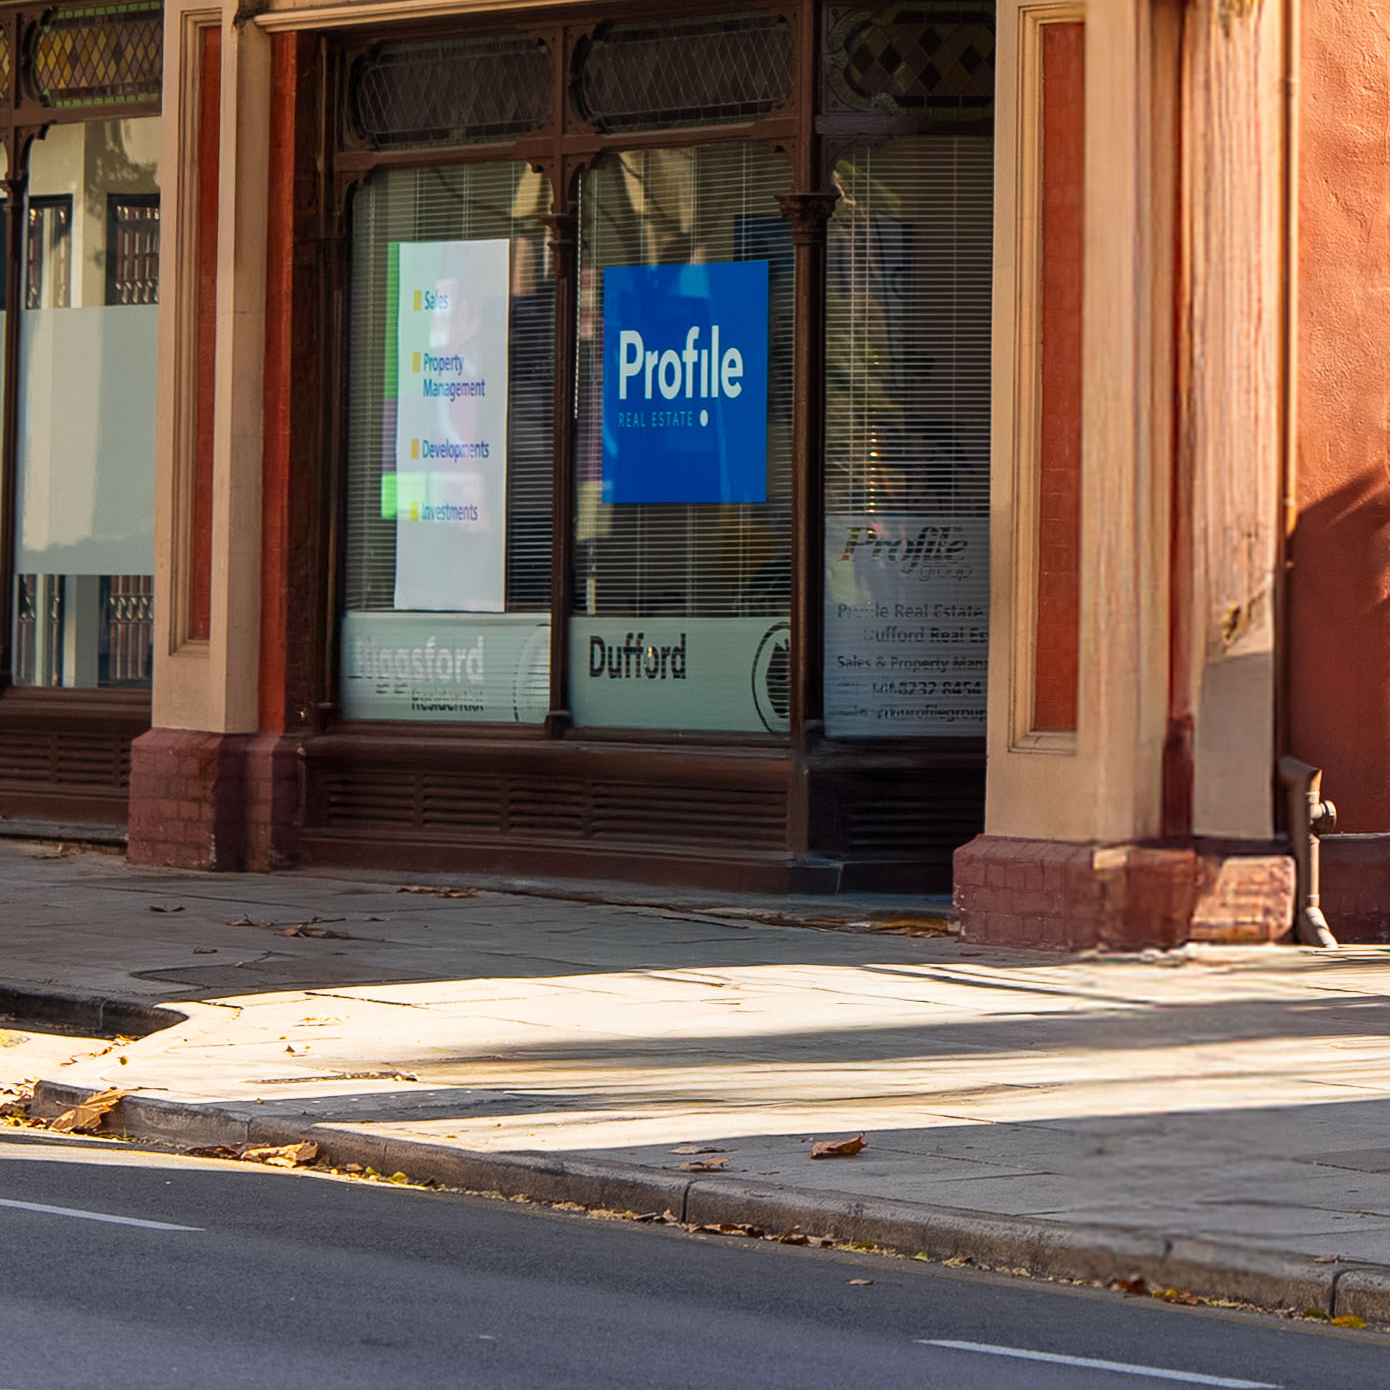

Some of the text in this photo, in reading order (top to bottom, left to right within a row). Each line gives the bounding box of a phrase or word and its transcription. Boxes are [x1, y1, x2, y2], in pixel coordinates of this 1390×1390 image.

[424, 290, 449, 311] Sales
[423, 352, 464, 376] Property
[619, 325, 743, 400] Profile
[423, 379, 486, 402] Management
[618, 410, 694, 428] REAL ESTATE
[422, 439, 490, 463] Developments
[421, 501, 479, 521] Investments
[894, 603, 929, 618] Real
[930, 627, 965, 643] Real
[589, 632, 687, 679] Dufford
[836, 655, 871, 668] Sales
